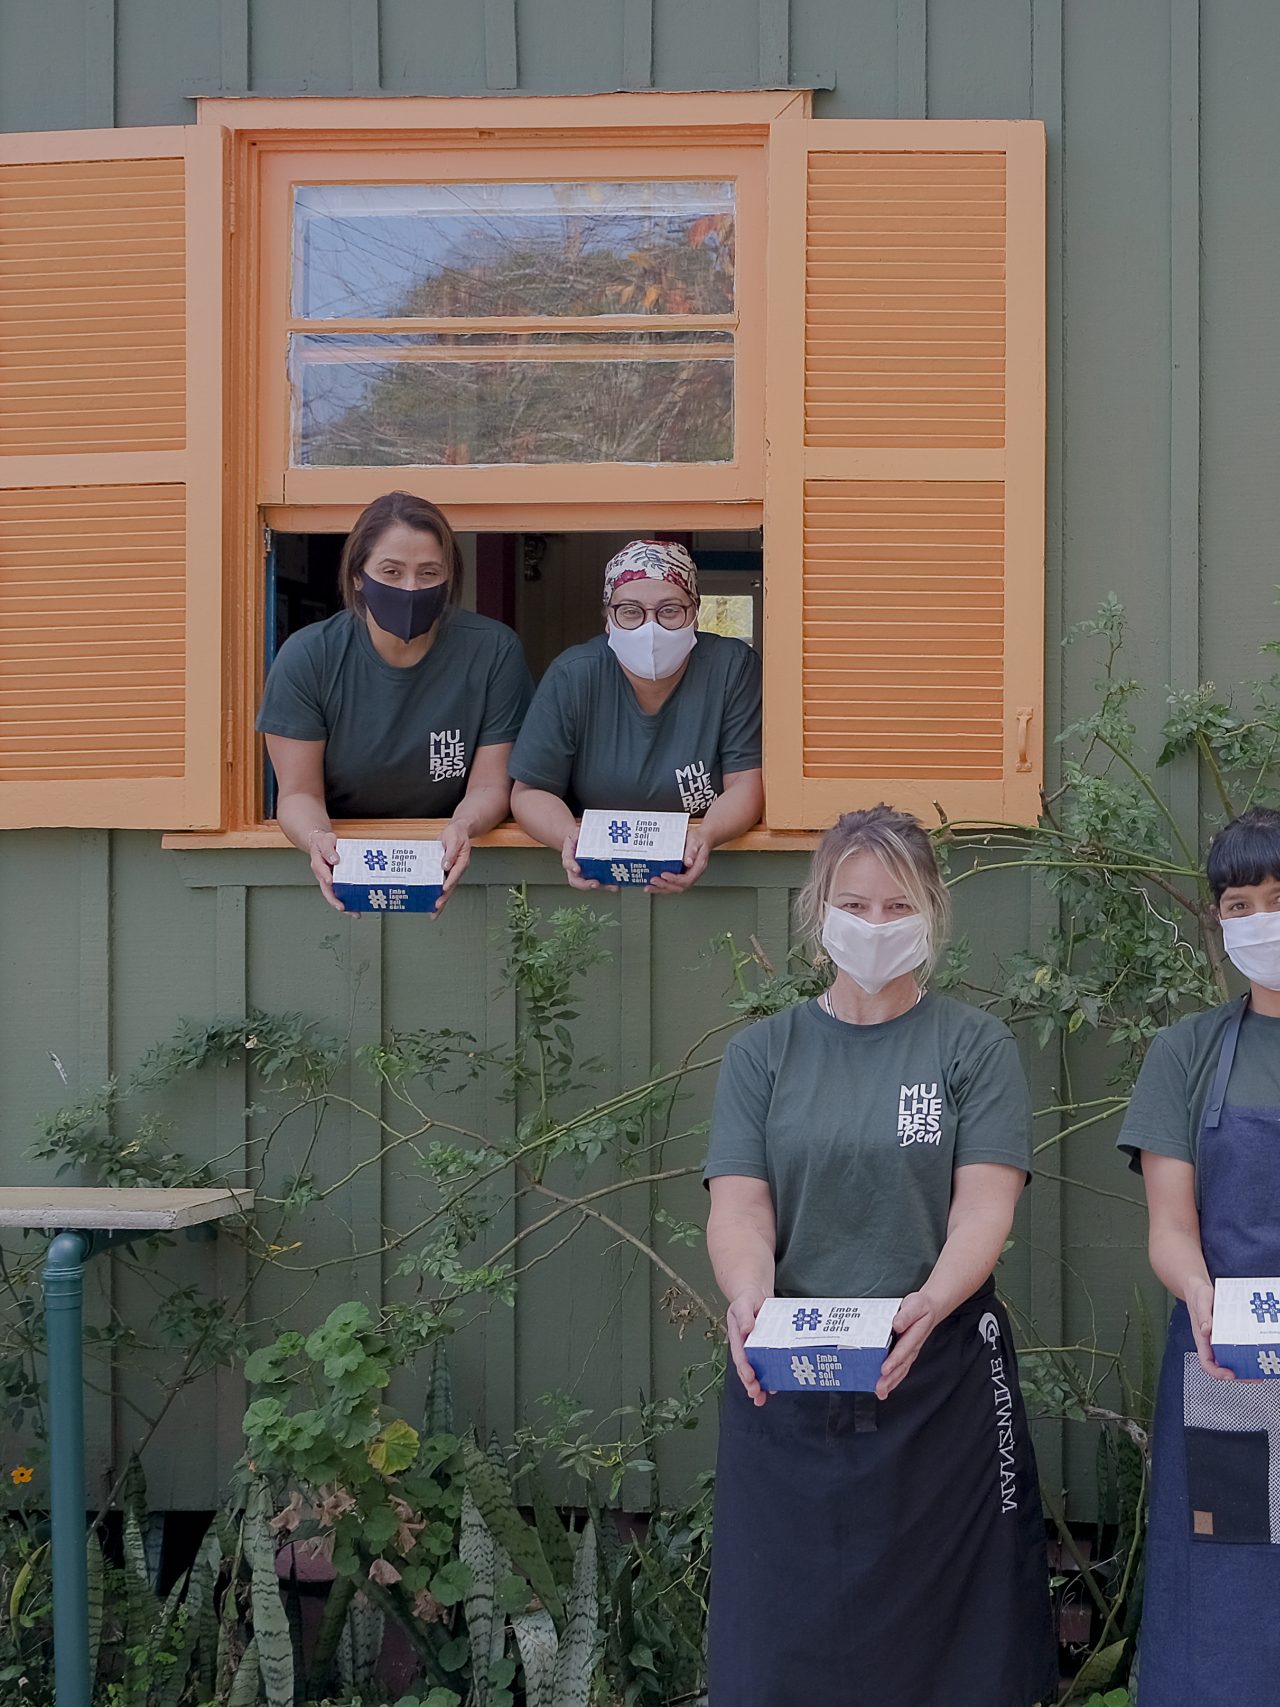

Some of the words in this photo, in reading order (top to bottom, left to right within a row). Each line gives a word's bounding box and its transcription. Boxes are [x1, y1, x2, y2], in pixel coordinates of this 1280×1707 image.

[430, 729, 460, 744] MU
[430, 742, 465, 757] LHE
[430, 756, 464, 771] RES
[675, 760, 705, 783] MU
[678, 772, 711, 797] LHE
[900, 1083, 938, 1100] MU
[899, 1098, 942, 1115] LHE
[897, 1113, 940, 1131] RES
[828, 1312, 861, 1320] lagem
